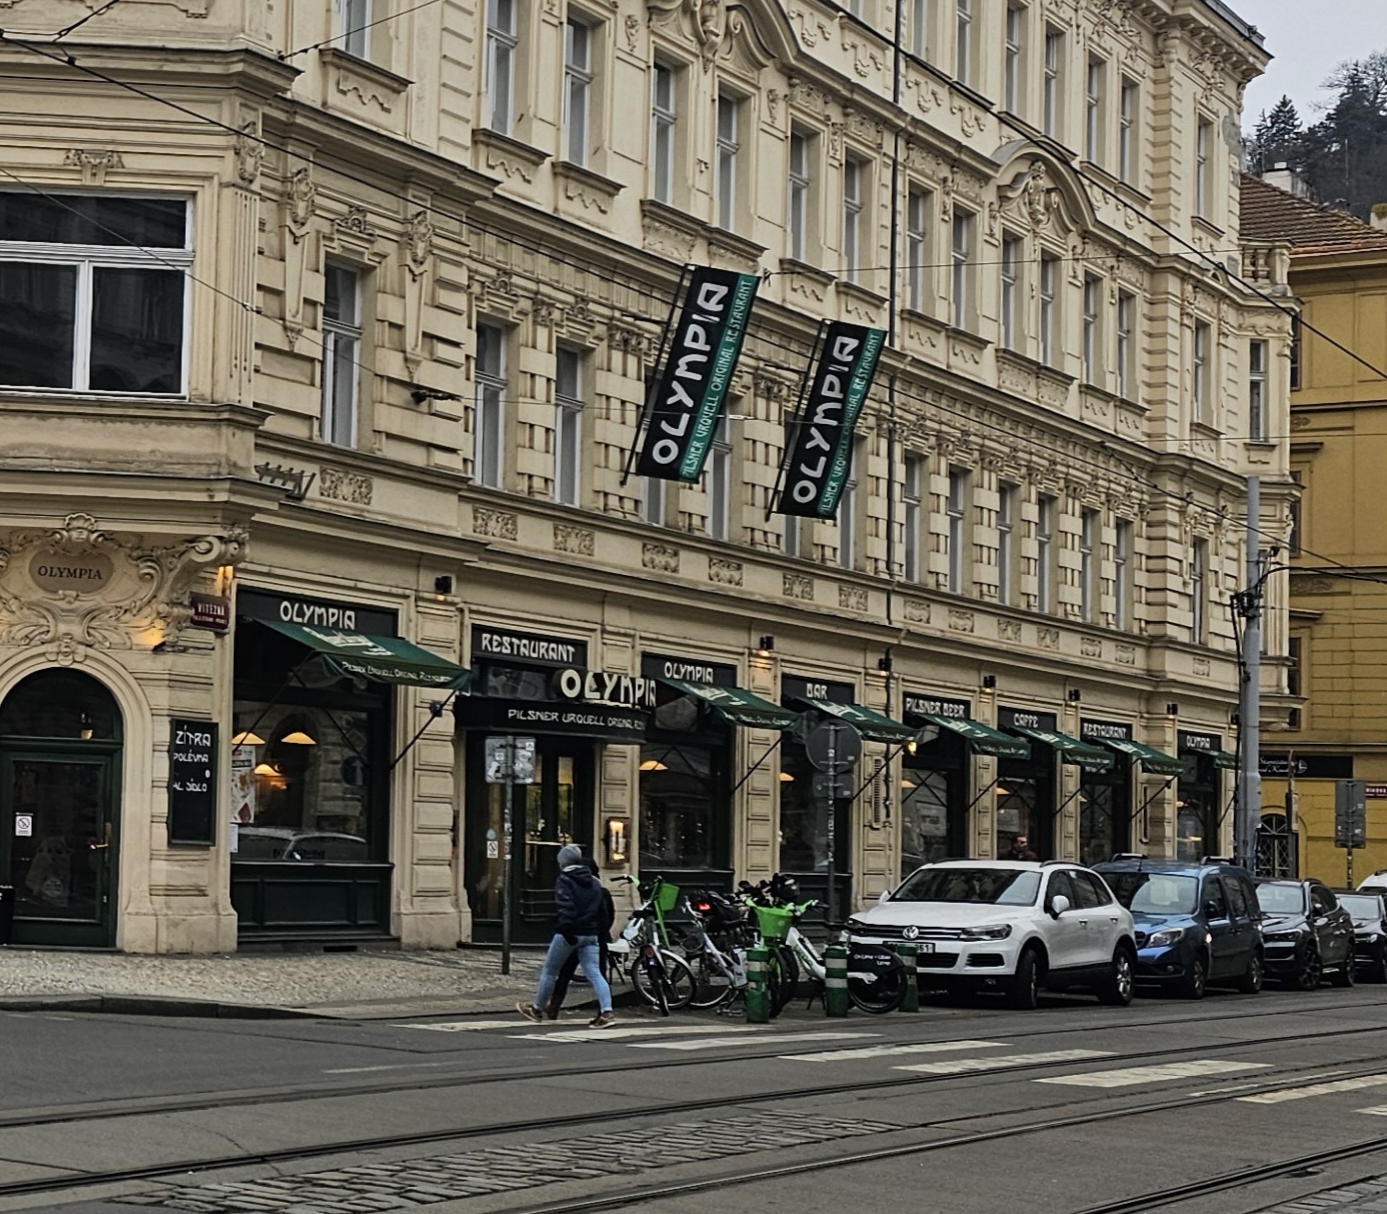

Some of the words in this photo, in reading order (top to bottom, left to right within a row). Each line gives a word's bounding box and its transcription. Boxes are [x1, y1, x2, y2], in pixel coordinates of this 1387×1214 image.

[711, 346, 735, 391] ORIGINAL
[725, 280, 753, 343] RESTAURANT
[652, 282, 729, 464] OLYMPIA
[852, 333, 880, 391] RESTAURANT
[792, 336, 860, 504] OLYMPIA
[38, 565, 103, 580] OLYMPIA
[280, 601, 356, 630] OLYMPIA
[482, 633, 576, 662] RESTAURANT
[664, 662, 714, 684] OLYMPIA
[561, 669, 656, 708] OLYMPIA
[806, 684, 828, 700] BAR
[508, 710, 560, 722] PILSNER
[562, 713, 606, 726] URQUELL
[906, 698, 942, 715] PILSNER
[942, 703, 965, 718] BEER
[176, 724, 211, 747] ZÍTRA
[1083, 722, 1127, 738] RESTAURANT
[1186, 735, 1212, 748] OLYMPIA
[186, 778, 208, 792] JÍDLO
